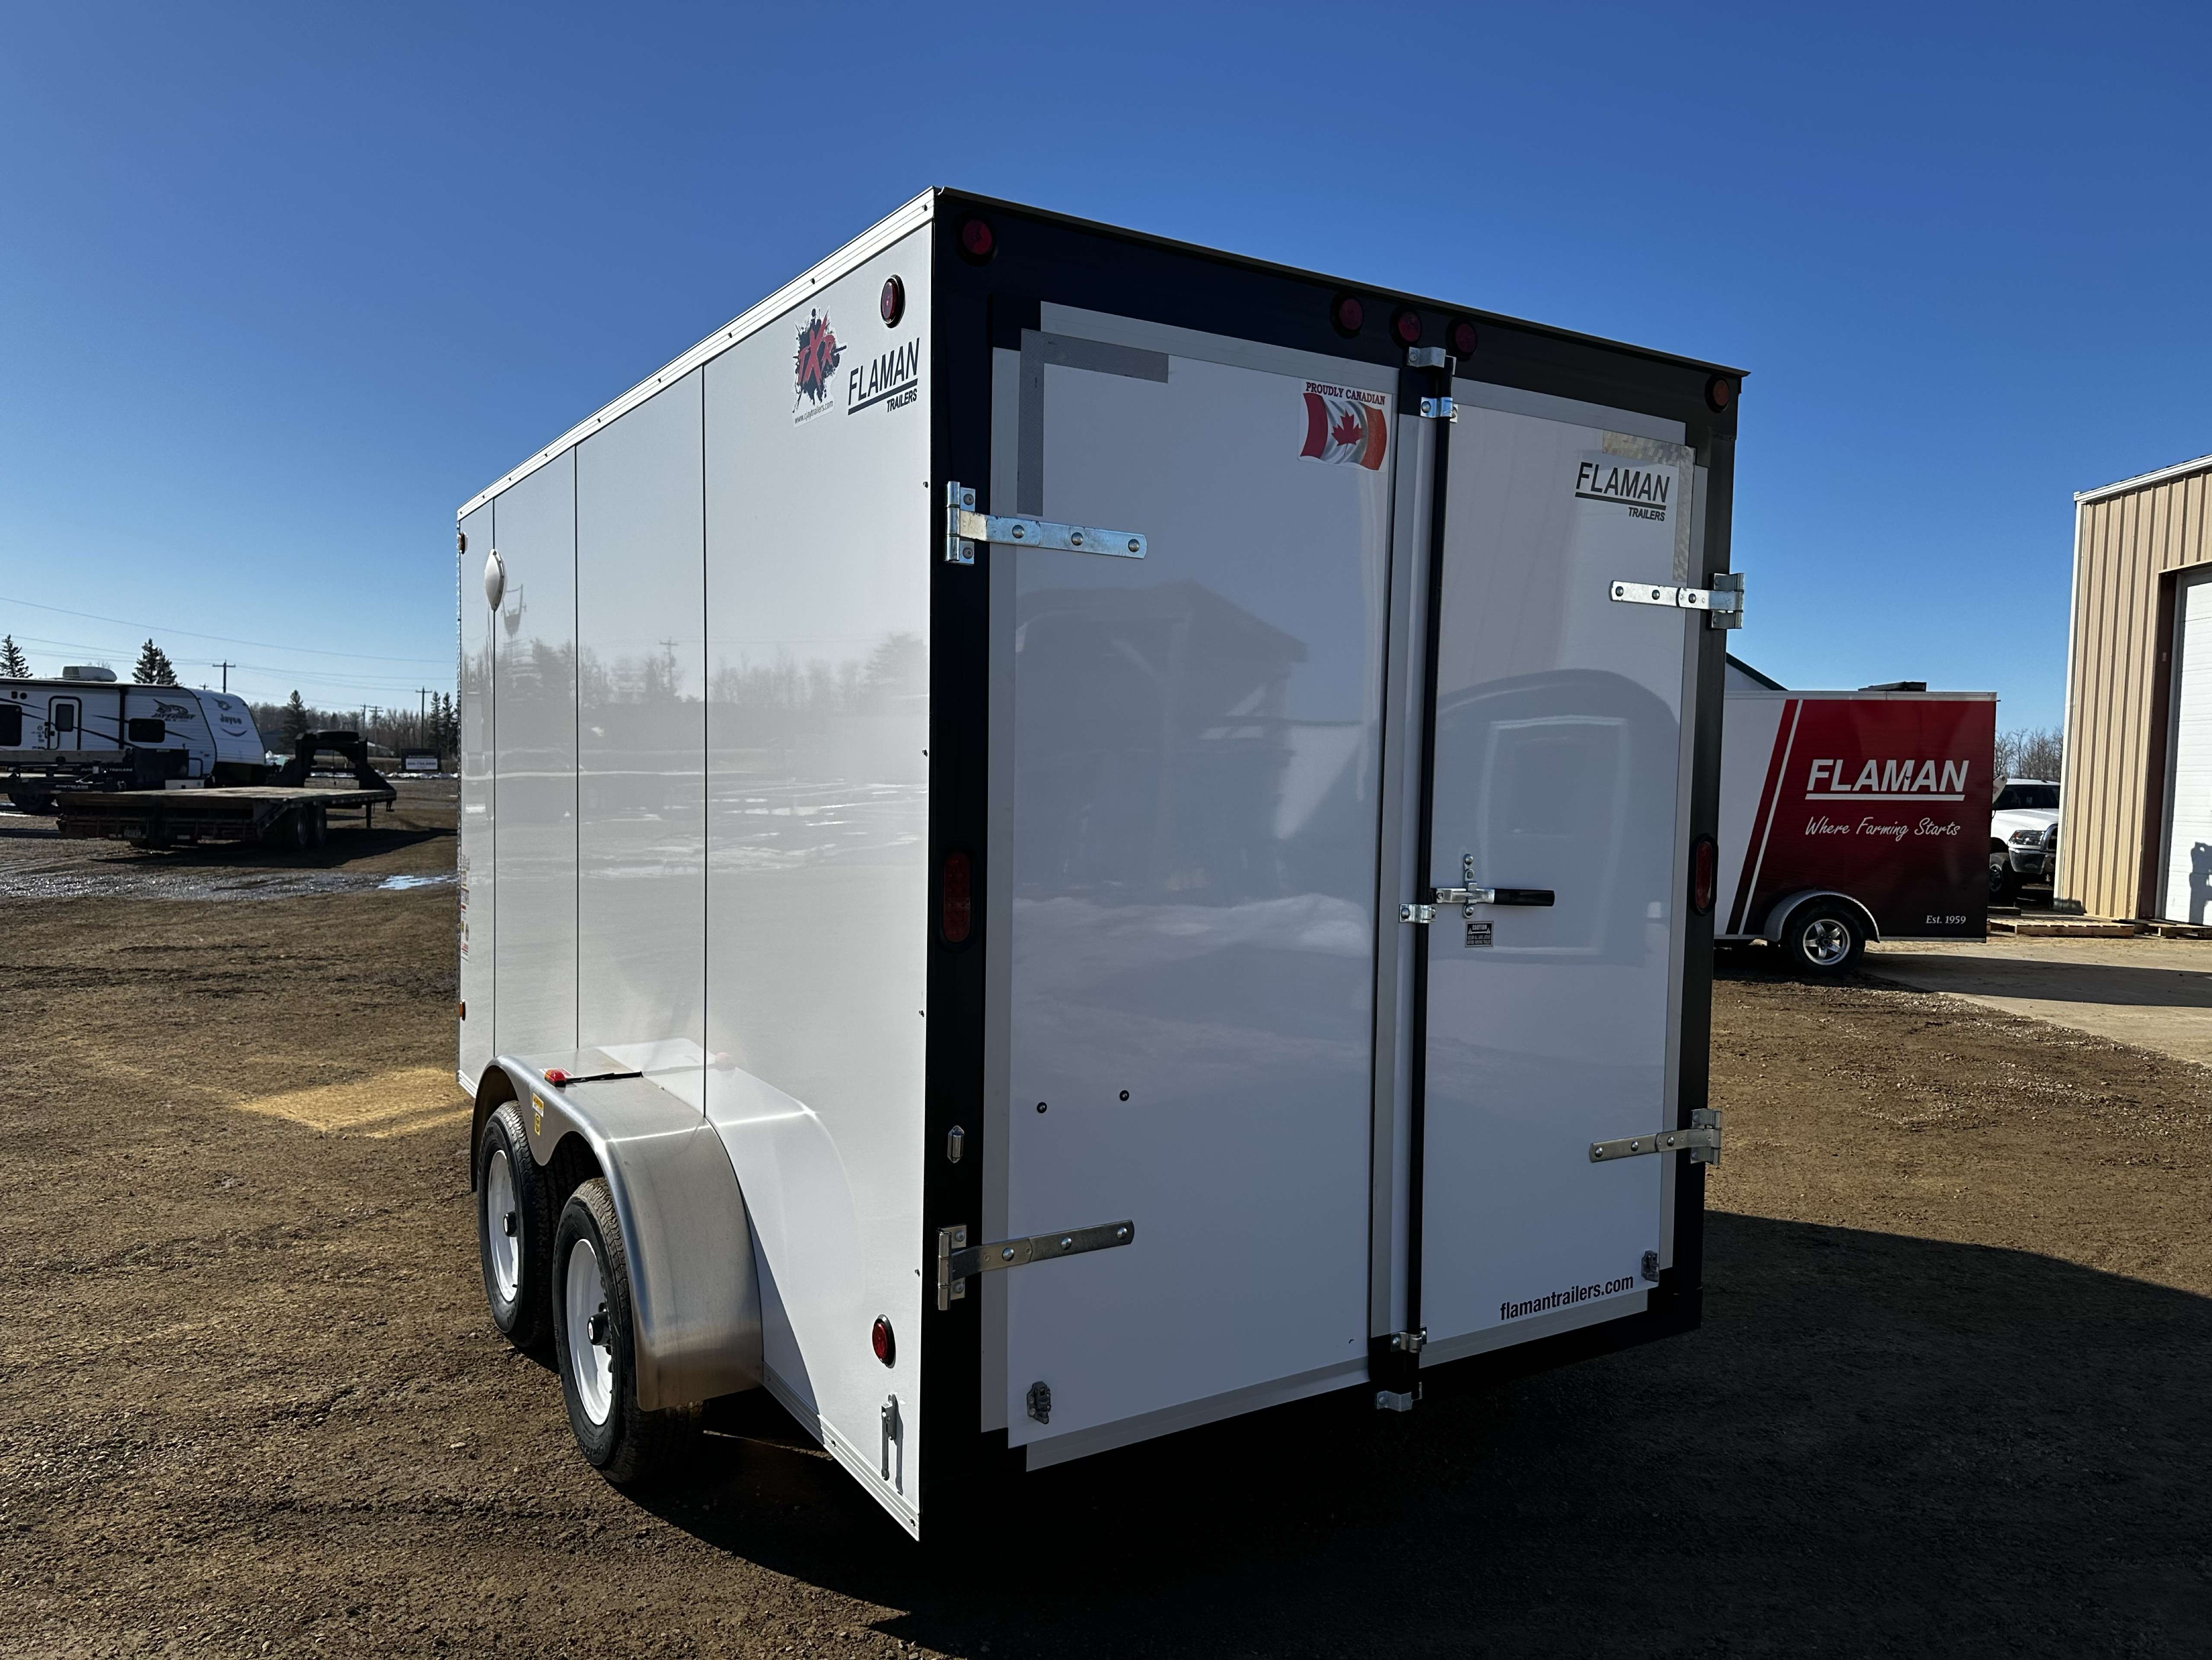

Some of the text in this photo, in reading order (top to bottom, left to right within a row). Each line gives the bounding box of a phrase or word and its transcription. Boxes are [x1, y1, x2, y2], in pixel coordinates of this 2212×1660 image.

[848, 337, 920, 406] FLAMAN
[886, 388, 917, 413] TRAILERS
[1306, 382, 1386, 405] PROUDLY CANADIAN
[1576, 462, 1670, 503] FLAMAN
[1629, 507, 1665, 521] TRAILERS
[220, 714, 242, 725] Jayco
[1807, 759, 1970, 792] FLAMAN
[1805, 816, 1960, 841] Where Farming Starts
[1926, 915, 1967, 925] Est. 1959
[1500, 1275, 1634, 1321] flamantrailers.com
